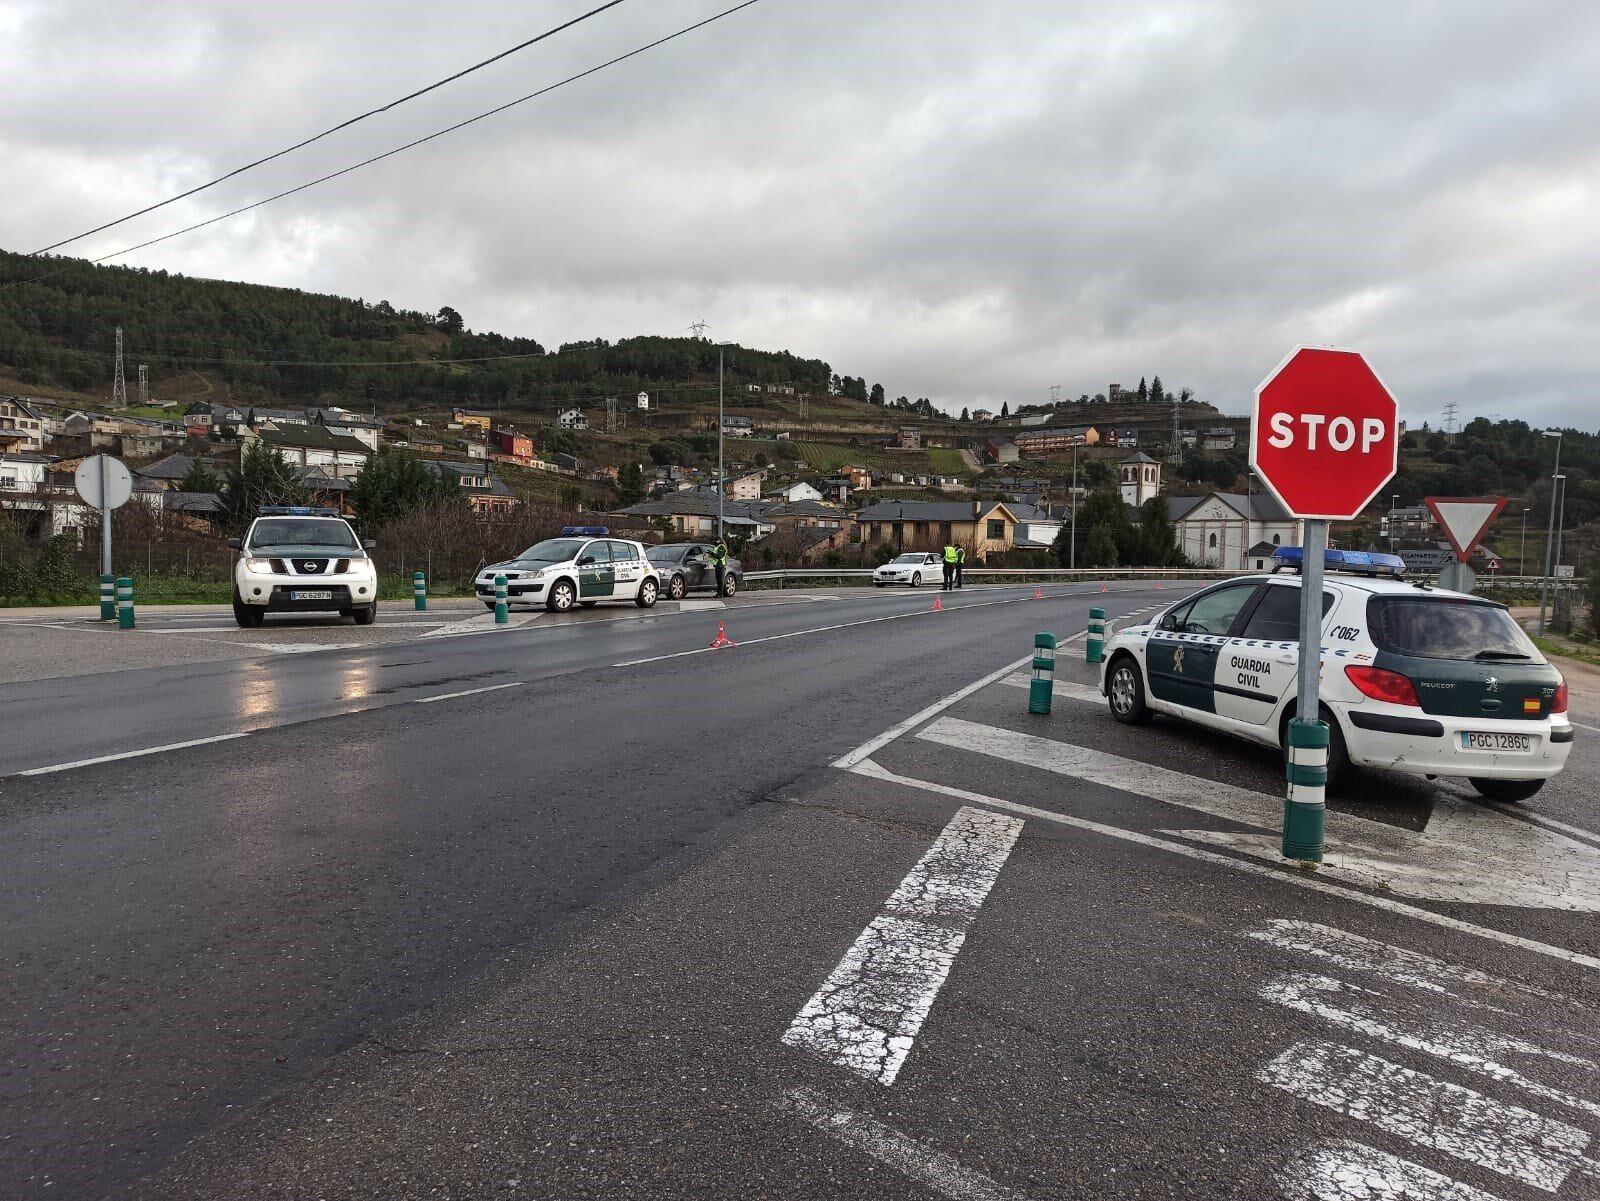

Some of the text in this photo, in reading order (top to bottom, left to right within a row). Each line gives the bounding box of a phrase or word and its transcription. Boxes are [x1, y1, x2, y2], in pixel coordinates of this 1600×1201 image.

[1267, 412, 1385, 454] STOP
[1338, 626, 1360, 642] 062
[1231, 656, 1271, 674] GUARDIA
[1237, 673, 1261, 688] CIVIL
